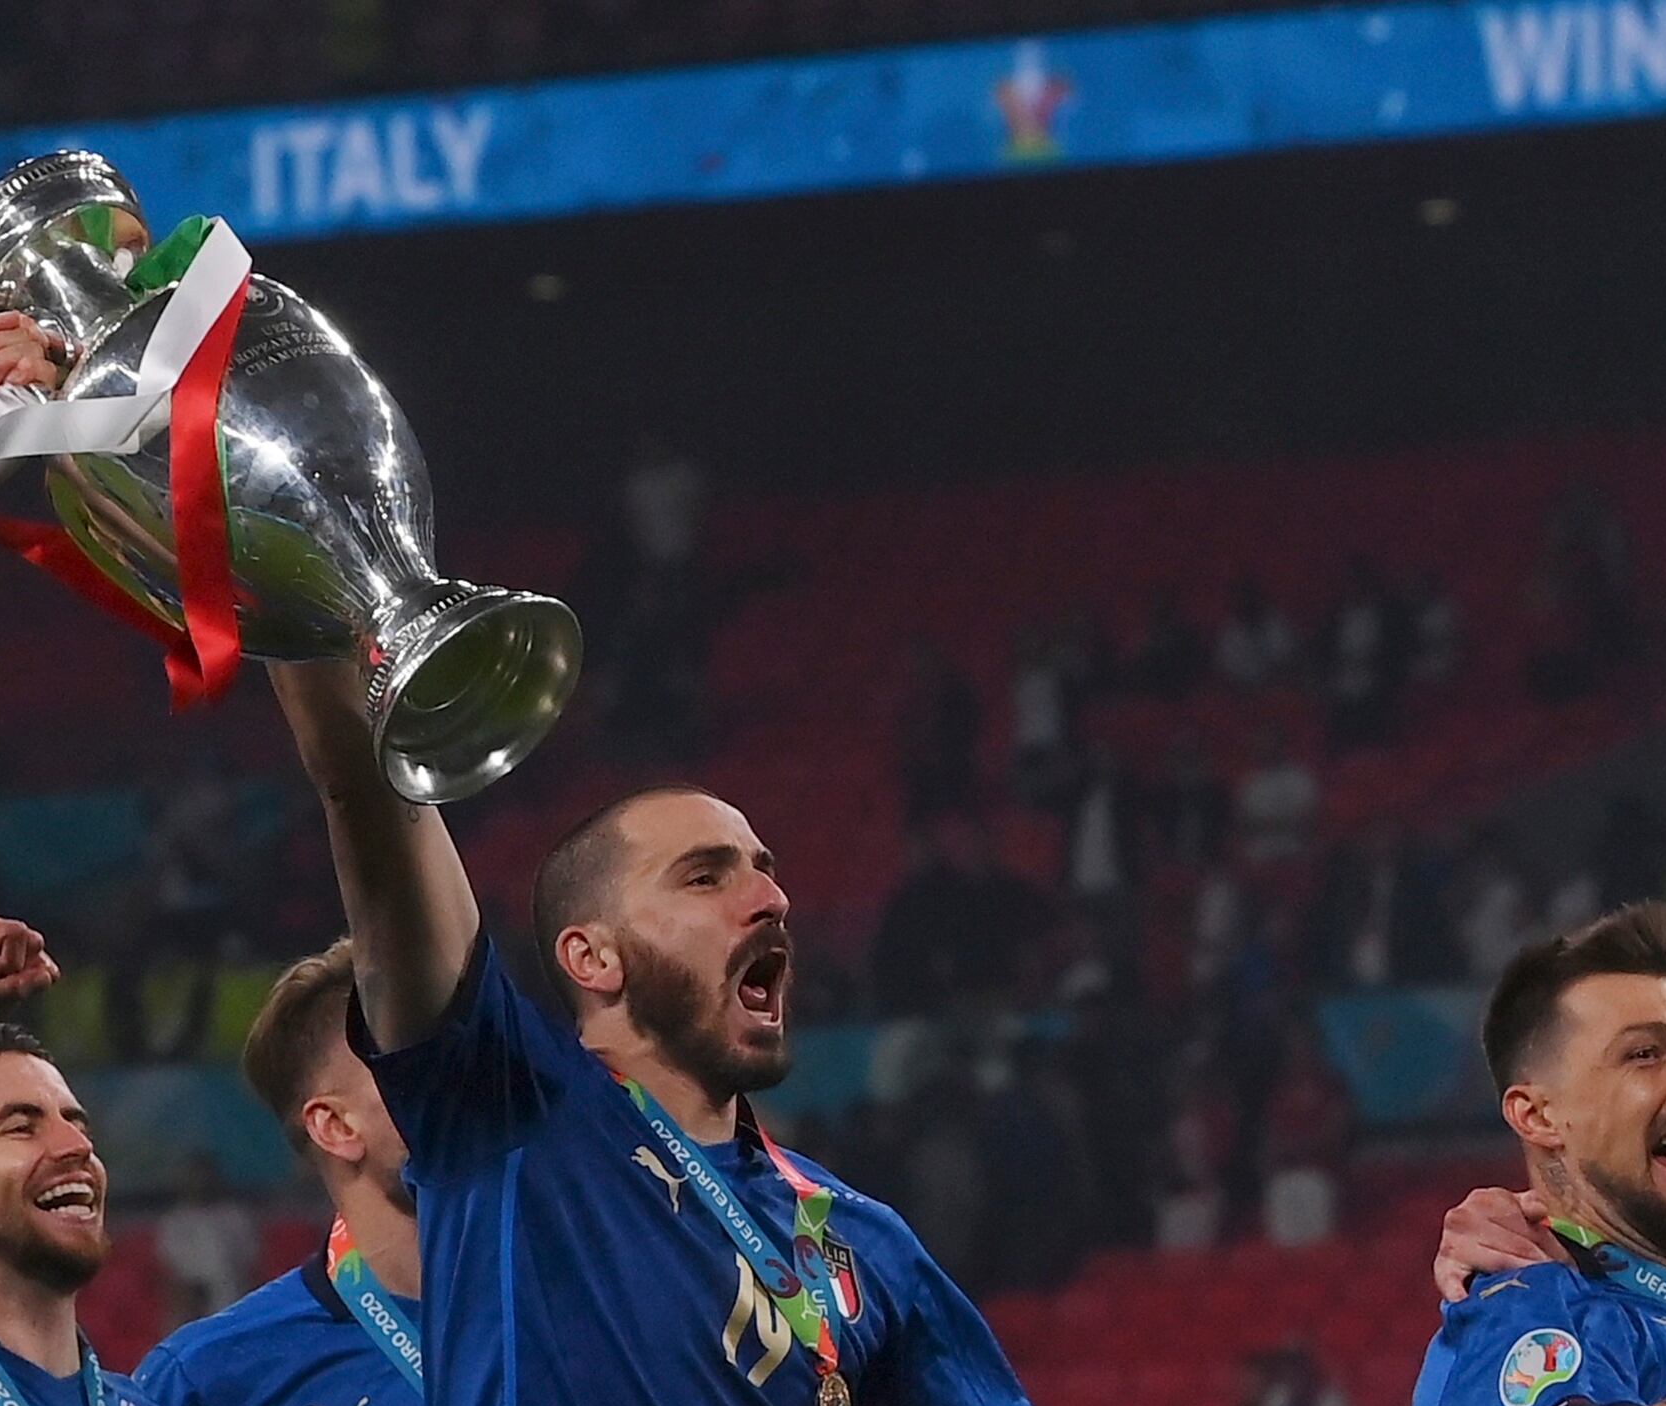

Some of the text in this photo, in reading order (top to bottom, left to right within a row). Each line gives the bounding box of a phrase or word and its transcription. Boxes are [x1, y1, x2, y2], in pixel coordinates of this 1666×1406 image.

[250, 101, 493, 225] ITALY
[227, 336, 291, 372] UROPEAN
[685, 1160, 729, 1208] EURO
[724, 1202, 763, 1254] UEFA
[824, 1246, 848, 1265] LIA
[359, 1291, 399, 1336] 2020
[722, 1252, 793, 1388] 19
